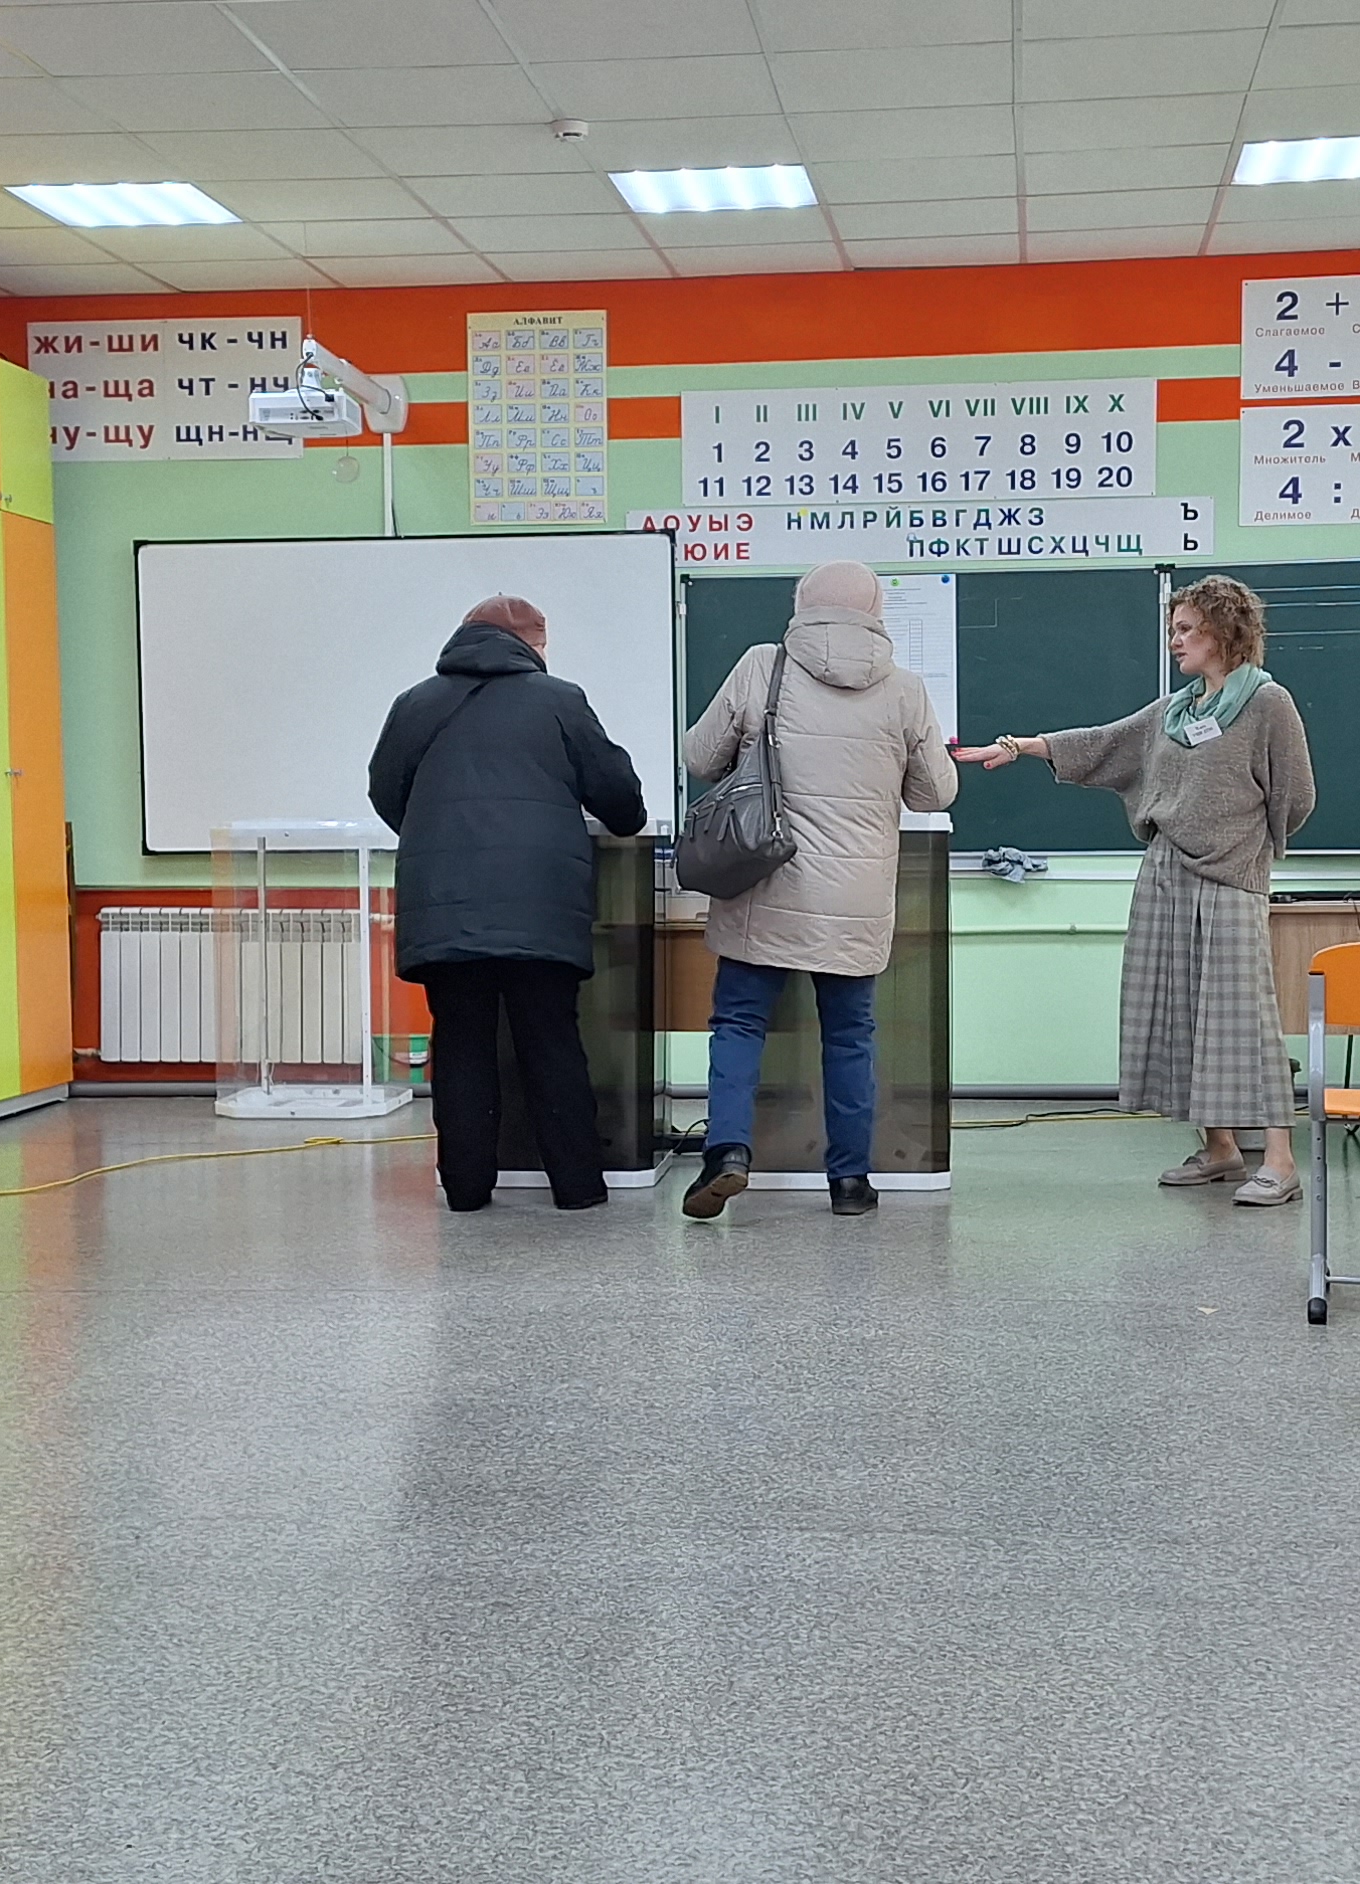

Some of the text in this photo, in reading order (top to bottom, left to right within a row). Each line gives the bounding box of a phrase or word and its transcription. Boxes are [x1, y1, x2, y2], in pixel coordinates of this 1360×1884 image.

[1276, 291, 1299, 321] 2
[1325, 292, 1350, 316] +
[514, 317, 563, 325] АЛФАВИТ
[1254, 327, 1326, 338] Слагаемое
[1274, 348, 1299, 378] 4
[1254, 382, 1345, 394] Уменьшаемое
[756, 404, 768, 423] II
[797, 403, 817, 422] III
[842, 402, 866, 421] IV
[888, 400, 904, 419] V
[928, 399, 950, 418] VI
[965, 398, 996, 417] VII
[1010, 396, 1049, 416] VIII
[1065, 395, 1089, 414] IX
[712, 431, 1133, 463] 1 2 3 4 5 6 7 8 9 10
[1282, 419, 1305, 449] 2
[1253, 454, 1327, 465] Множитель
[698, 465, 1133, 498] 11 12 13 14 15 16 17 18 19 20
[1278, 476, 1303, 505] 4
[1253, 510, 1312, 523] Делимое
